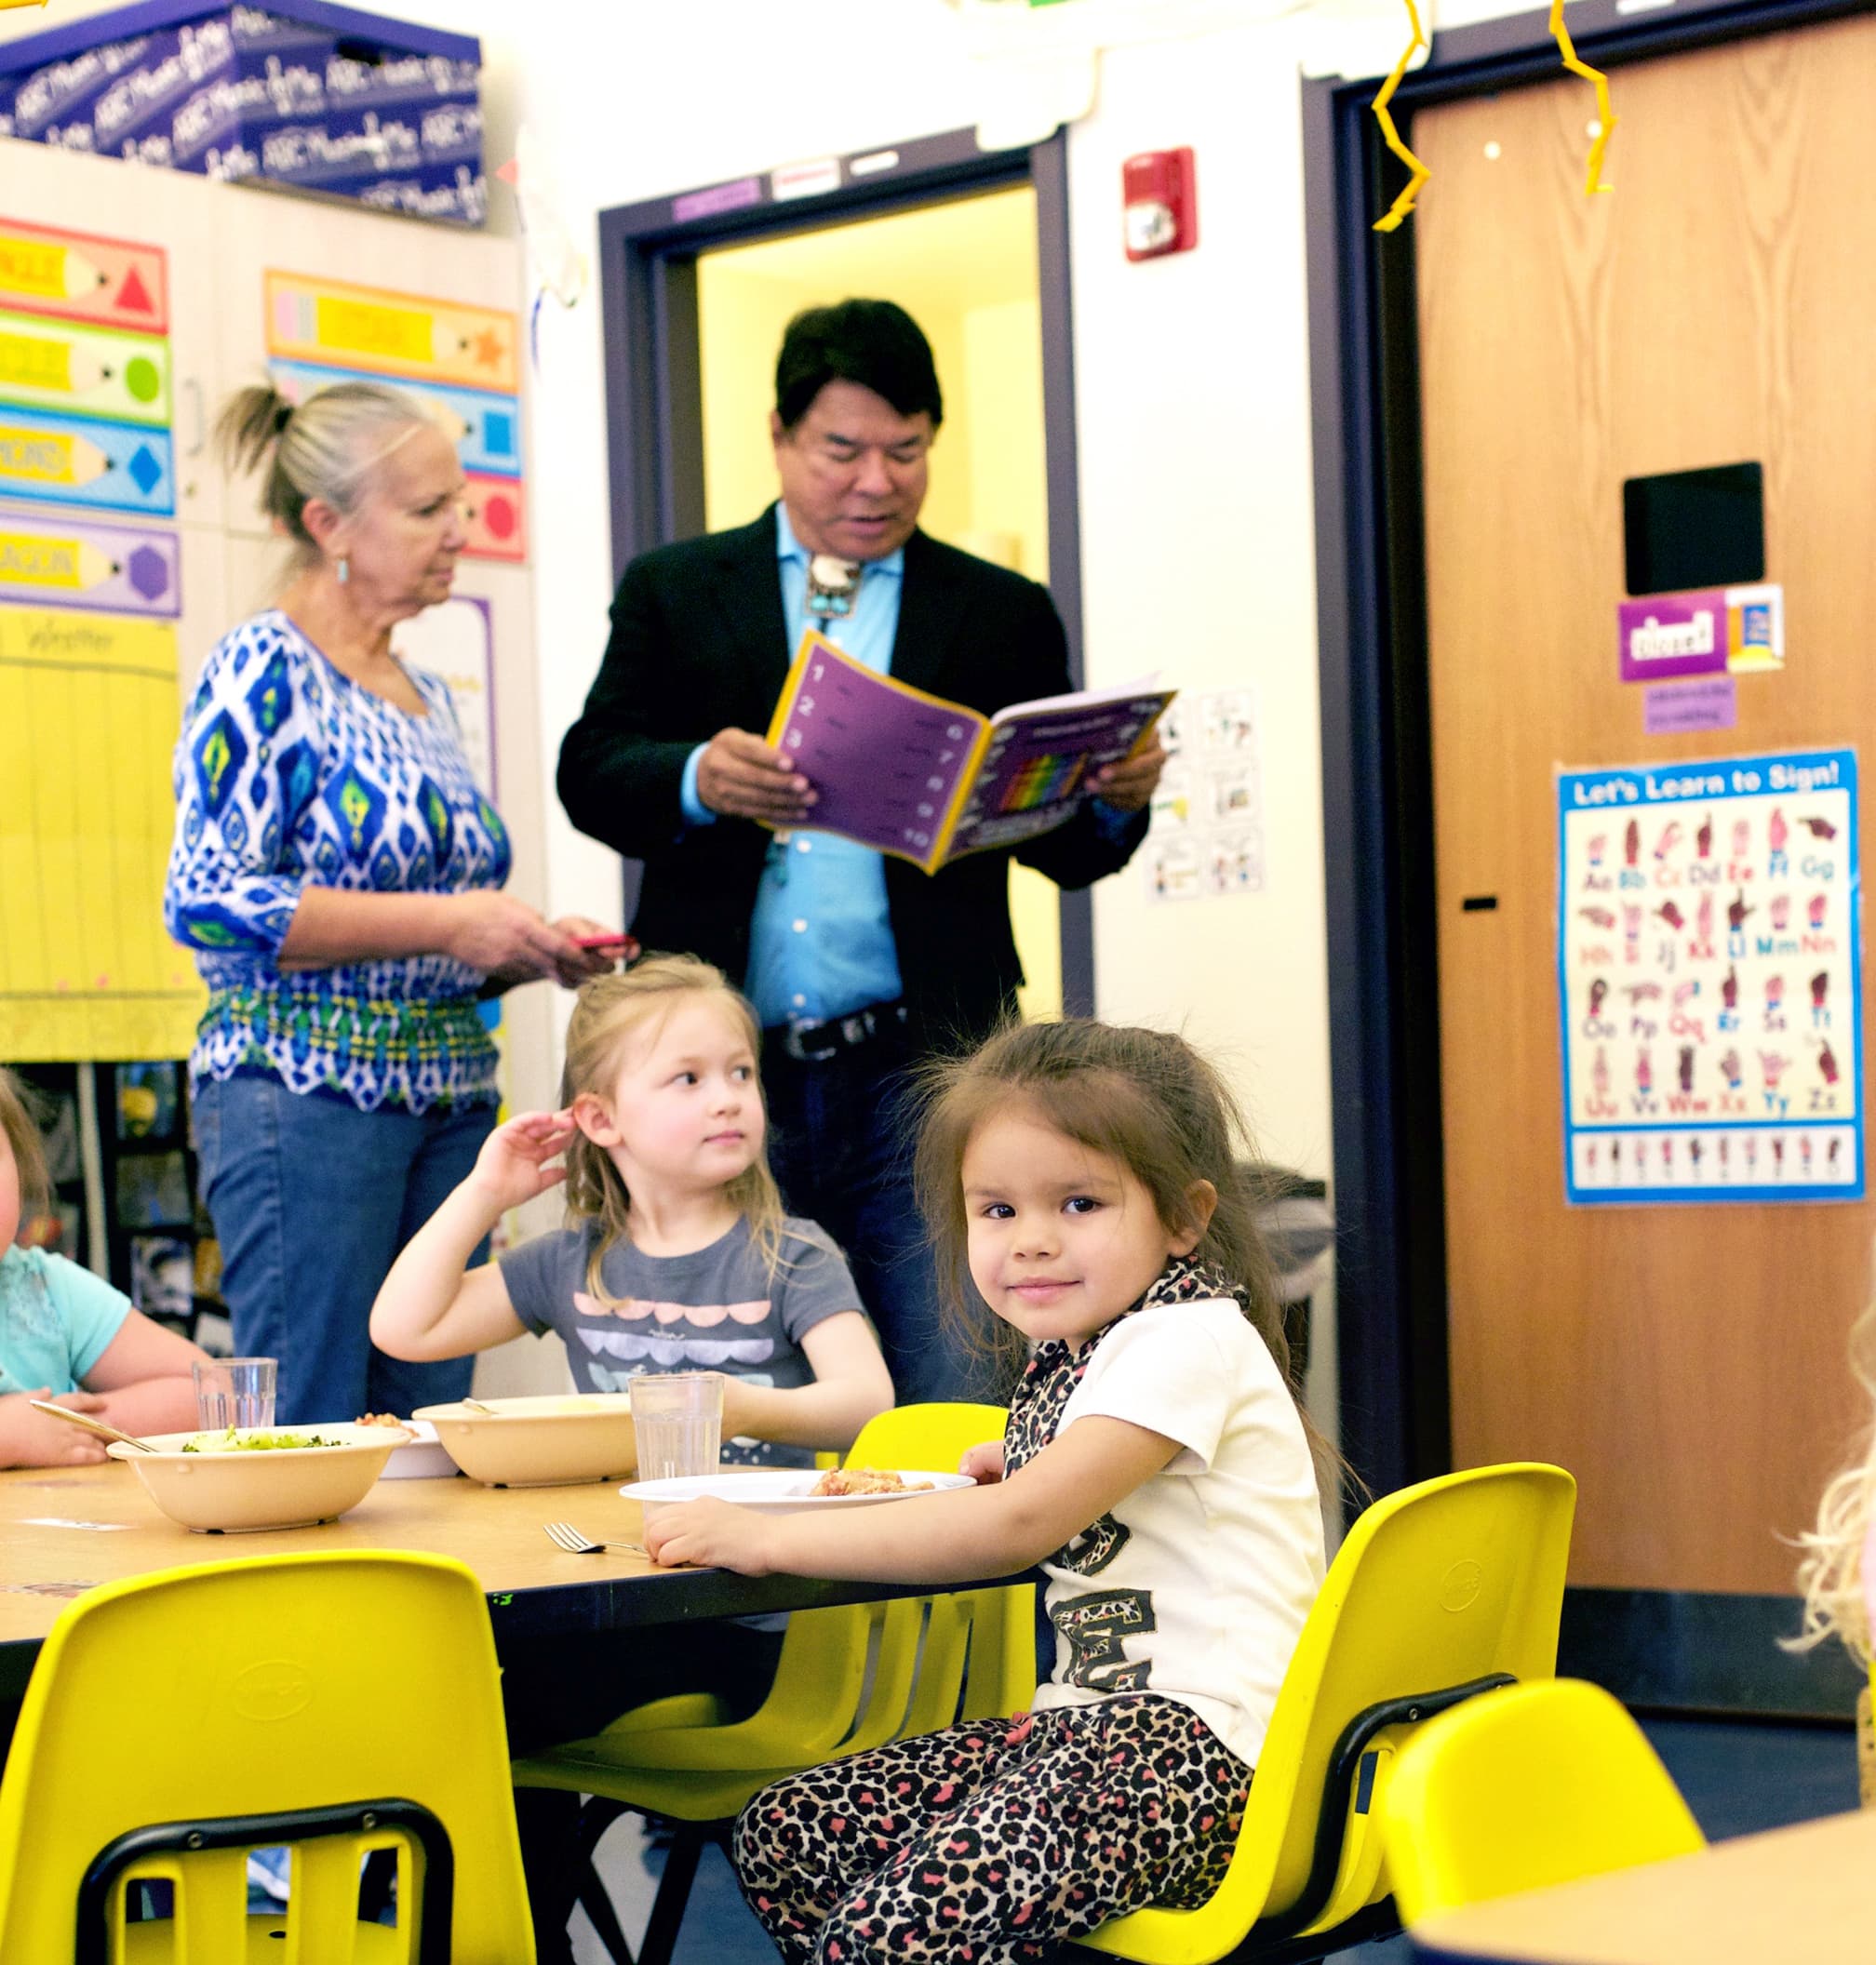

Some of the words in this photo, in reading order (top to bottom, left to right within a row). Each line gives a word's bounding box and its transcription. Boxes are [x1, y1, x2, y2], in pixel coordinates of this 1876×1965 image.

[813, 664, 824, 682] 1
[797, 695, 815, 716] 2
[1574, 778, 1638, 806] Let's
[1645, 773, 1725, 801] Learn
[1732, 769, 1762, 793] to
[1768, 759, 1840, 795] Sign!
[1689, 863, 1721, 884] Dd
[1802, 855, 1835, 880] Gg
[1756, 937, 1799, 956] Mm
[1763, 1090, 1789, 1120] Yy
